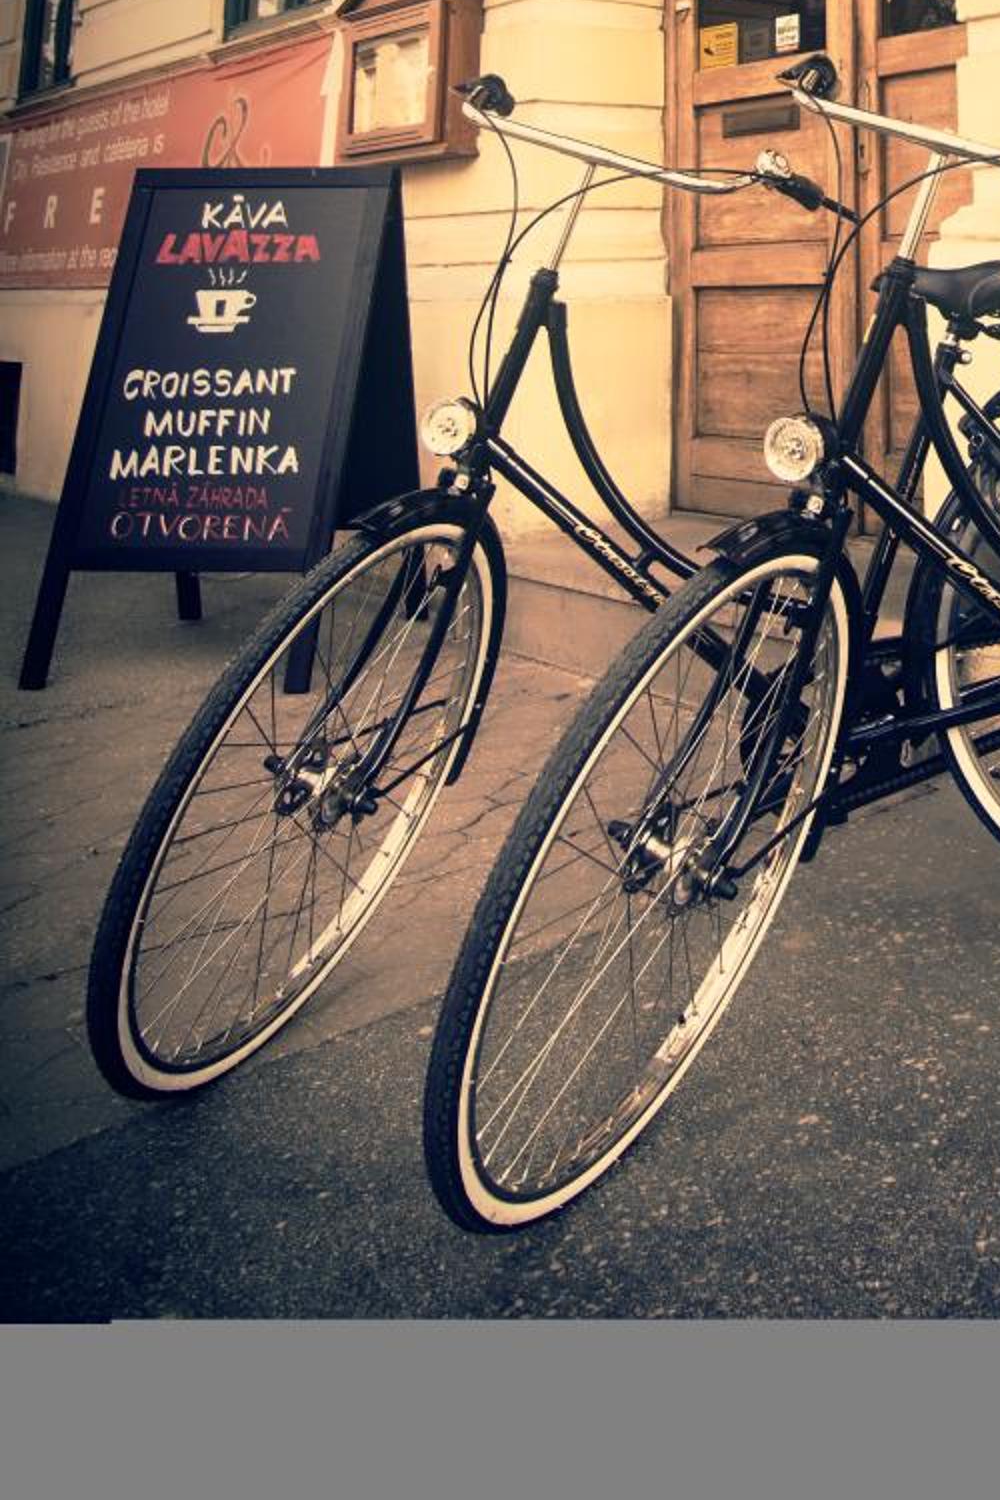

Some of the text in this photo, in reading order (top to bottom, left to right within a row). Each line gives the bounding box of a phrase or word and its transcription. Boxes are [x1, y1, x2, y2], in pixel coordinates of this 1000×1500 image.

[201, 194, 289, 229] KÁVA
[155, 229, 321, 264] LAVAZZA
[123, 367, 297, 400] CROISSANT
[144, 407, 271, 437] MUFFIN
[109, 444, 299, 480] MARLENKA
[186, 480, 270, 510] ZÁHRADA
[110, 506, 295, 542] OTVORENÁ
